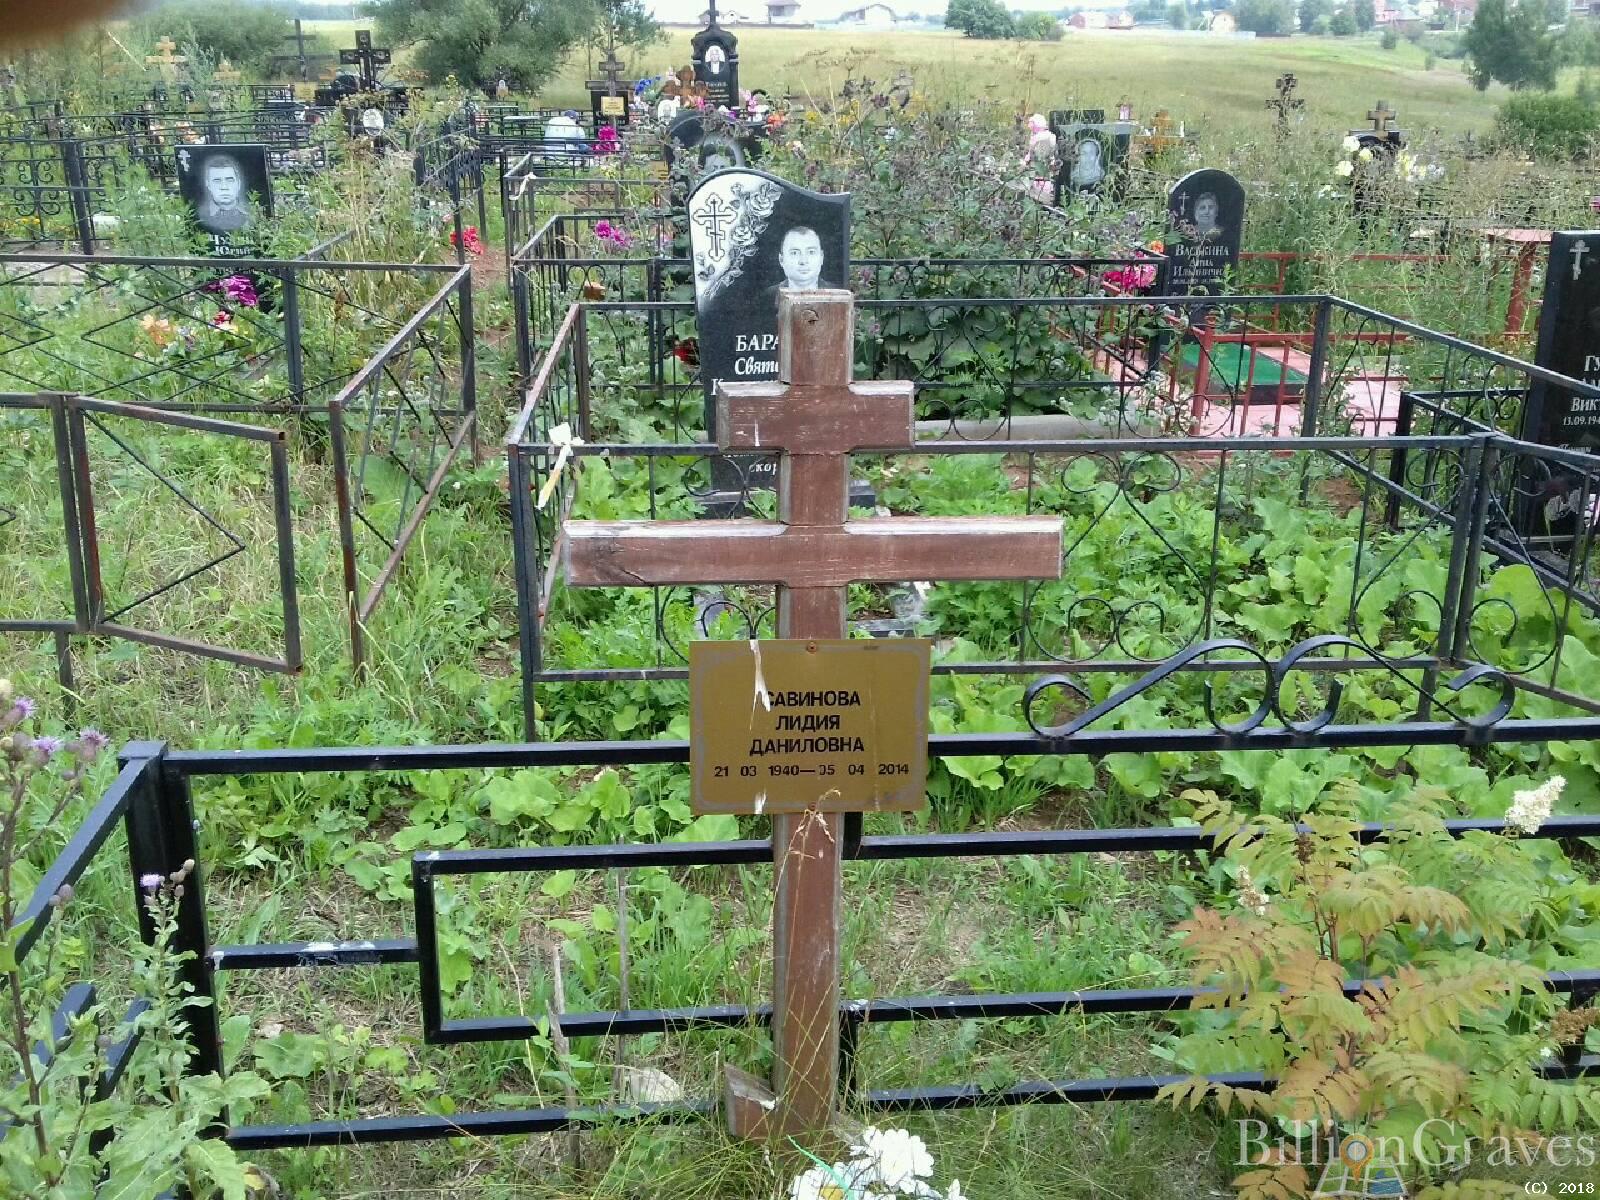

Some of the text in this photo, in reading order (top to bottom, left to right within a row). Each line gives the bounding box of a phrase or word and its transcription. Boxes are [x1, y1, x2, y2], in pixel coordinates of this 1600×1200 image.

[775, 714, 841, 732] ЛИДИЯ
[749, 736, 865, 756] ДАНИЛОВНА
[714, 765, 729, 777] 21
[740, 765, 757, 777] 03
[848, 764, 864, 775] 04
[878, 763, 909, 775] 2014
